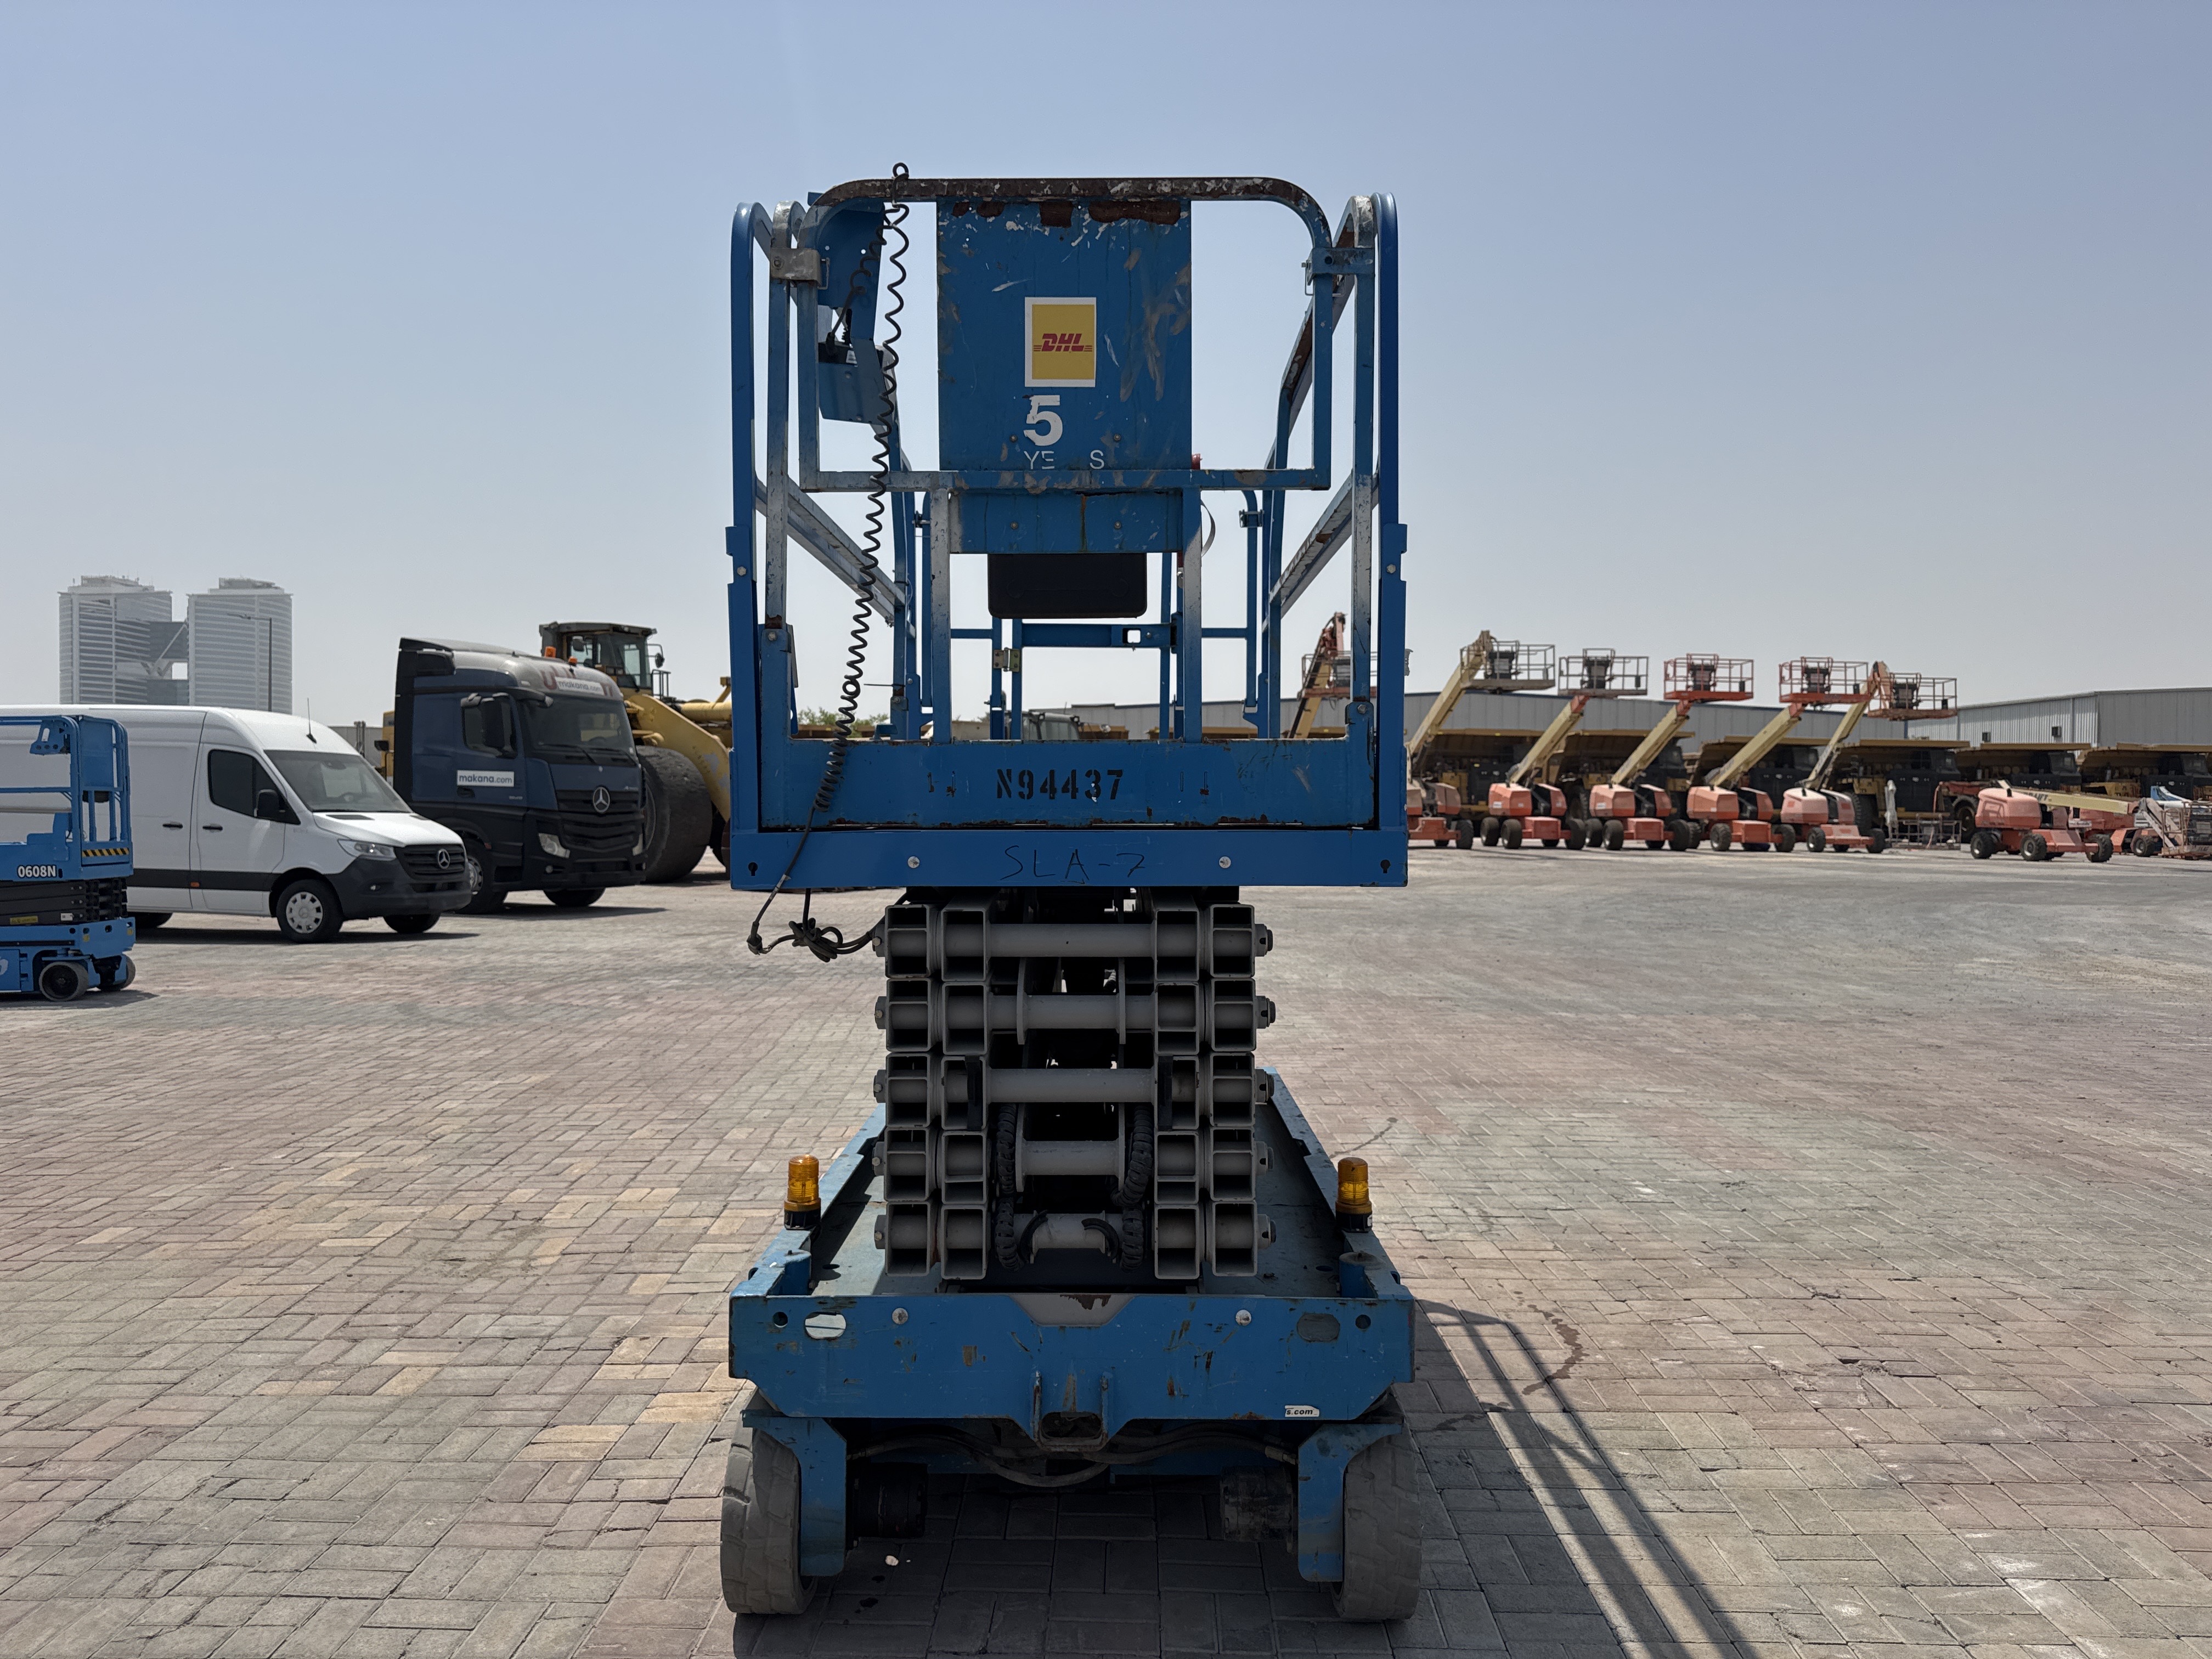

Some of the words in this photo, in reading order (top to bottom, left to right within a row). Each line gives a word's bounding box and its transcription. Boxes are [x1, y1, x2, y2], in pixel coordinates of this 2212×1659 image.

[1041, 334, 1084, 352] DHL
[1024, 395, 1063, 446] 5
[558, 681, 601, 691] makana.com
[459, 774, 512, 784] makana.com
[997, 769, 1123, 800] N94437
[18, 865, 56, 878] 0608N
